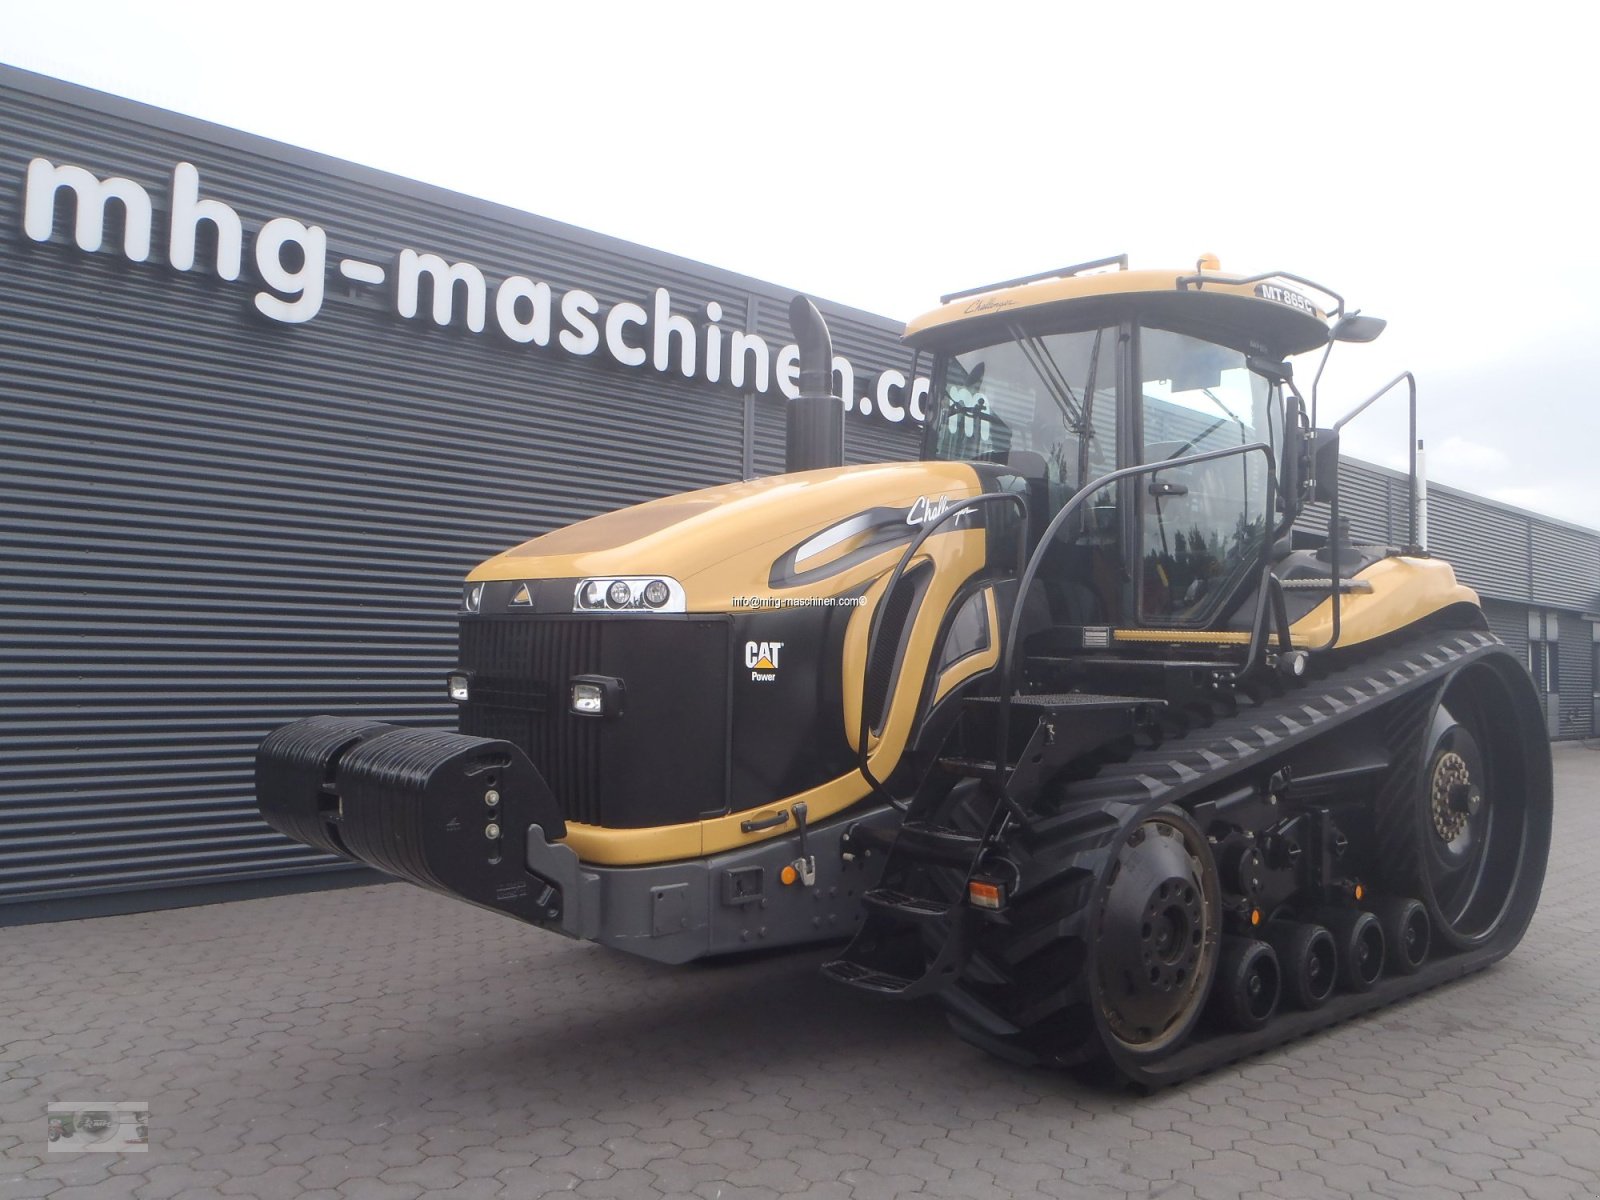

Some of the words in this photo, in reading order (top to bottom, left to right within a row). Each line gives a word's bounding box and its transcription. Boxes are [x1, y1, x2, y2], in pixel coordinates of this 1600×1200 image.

[1262, 284, 1282, 301] MT
[1283, 289, 1313, 312] 865C
[745, 641, 782, 669] CAT
[751, 671, 776, 682] Power
